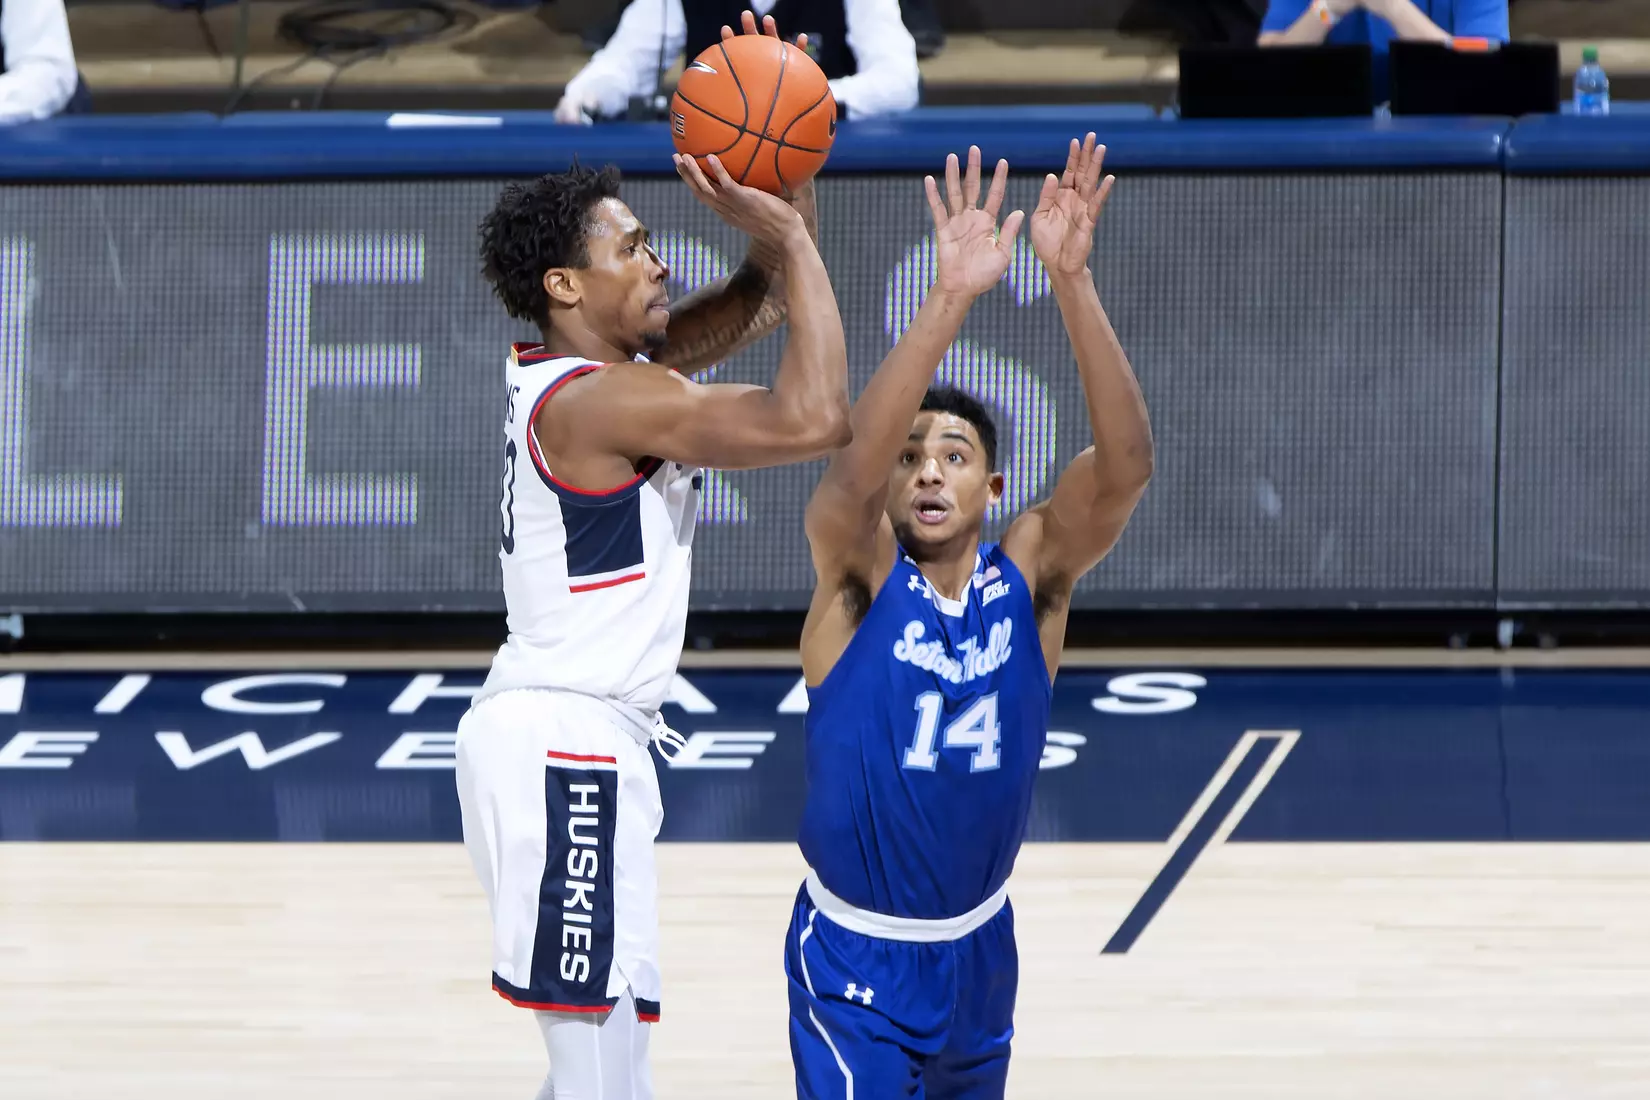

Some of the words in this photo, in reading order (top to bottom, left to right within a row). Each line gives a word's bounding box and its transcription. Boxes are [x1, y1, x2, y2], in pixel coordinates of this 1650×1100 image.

[893, 620, 963, 684] Seton
[956, 616, 1013, 684] Hall
[902, 690, 1001, 773] 14
[559, 783, 600, 984] HUSKIES
